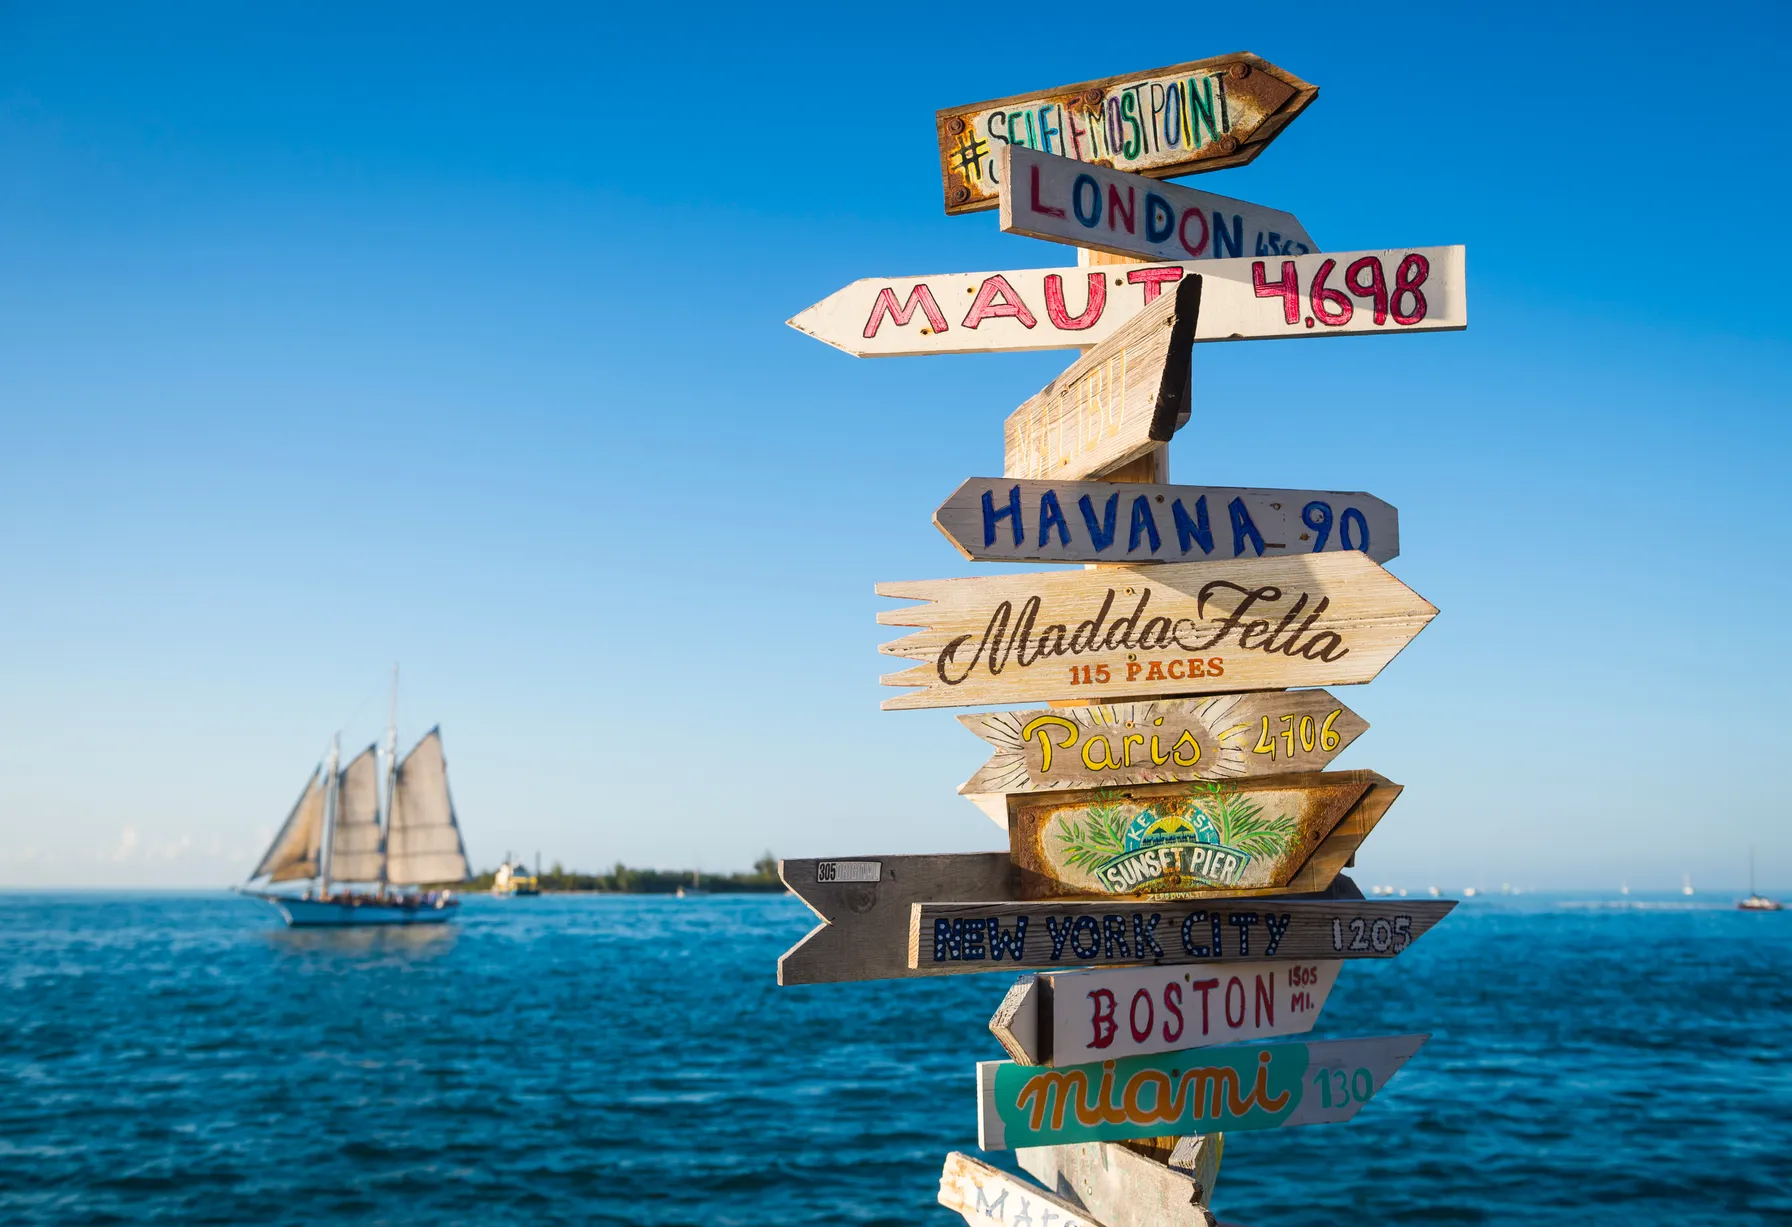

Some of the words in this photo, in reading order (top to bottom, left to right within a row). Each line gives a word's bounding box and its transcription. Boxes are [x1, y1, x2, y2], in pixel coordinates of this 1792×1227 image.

[1030, 165, 1243, 258] LONDON
[981, 484, 1265, 557] HAVANA
[1302, 500, 1369, 554] 90
[1070, 664, 1110, 686] 115
[1126, 656, 1225, 682] PACES
[1022, 714, 1201, 774] Paris
[1253, 708, 1343, 761] 4706
[1127, 805, 1158, 842] KEY
[1106, 848, 1183, 892] SUNSET
[1190, 848, 1237, 884] PIER
[933, 916, 1029, 962] NEW
[1046, 912, 1164, 961] YORK
[1181, 909, 1291, 957] CITY
[1332, 915, 1413, 955] 1205
[1289, 966, 1318, 988] 1505
[1086, 971, 1274, 1049] BOSTON
[1016, 1050, 1290, 1132] miami
[1313, 1066, 1374, 1109] 130
